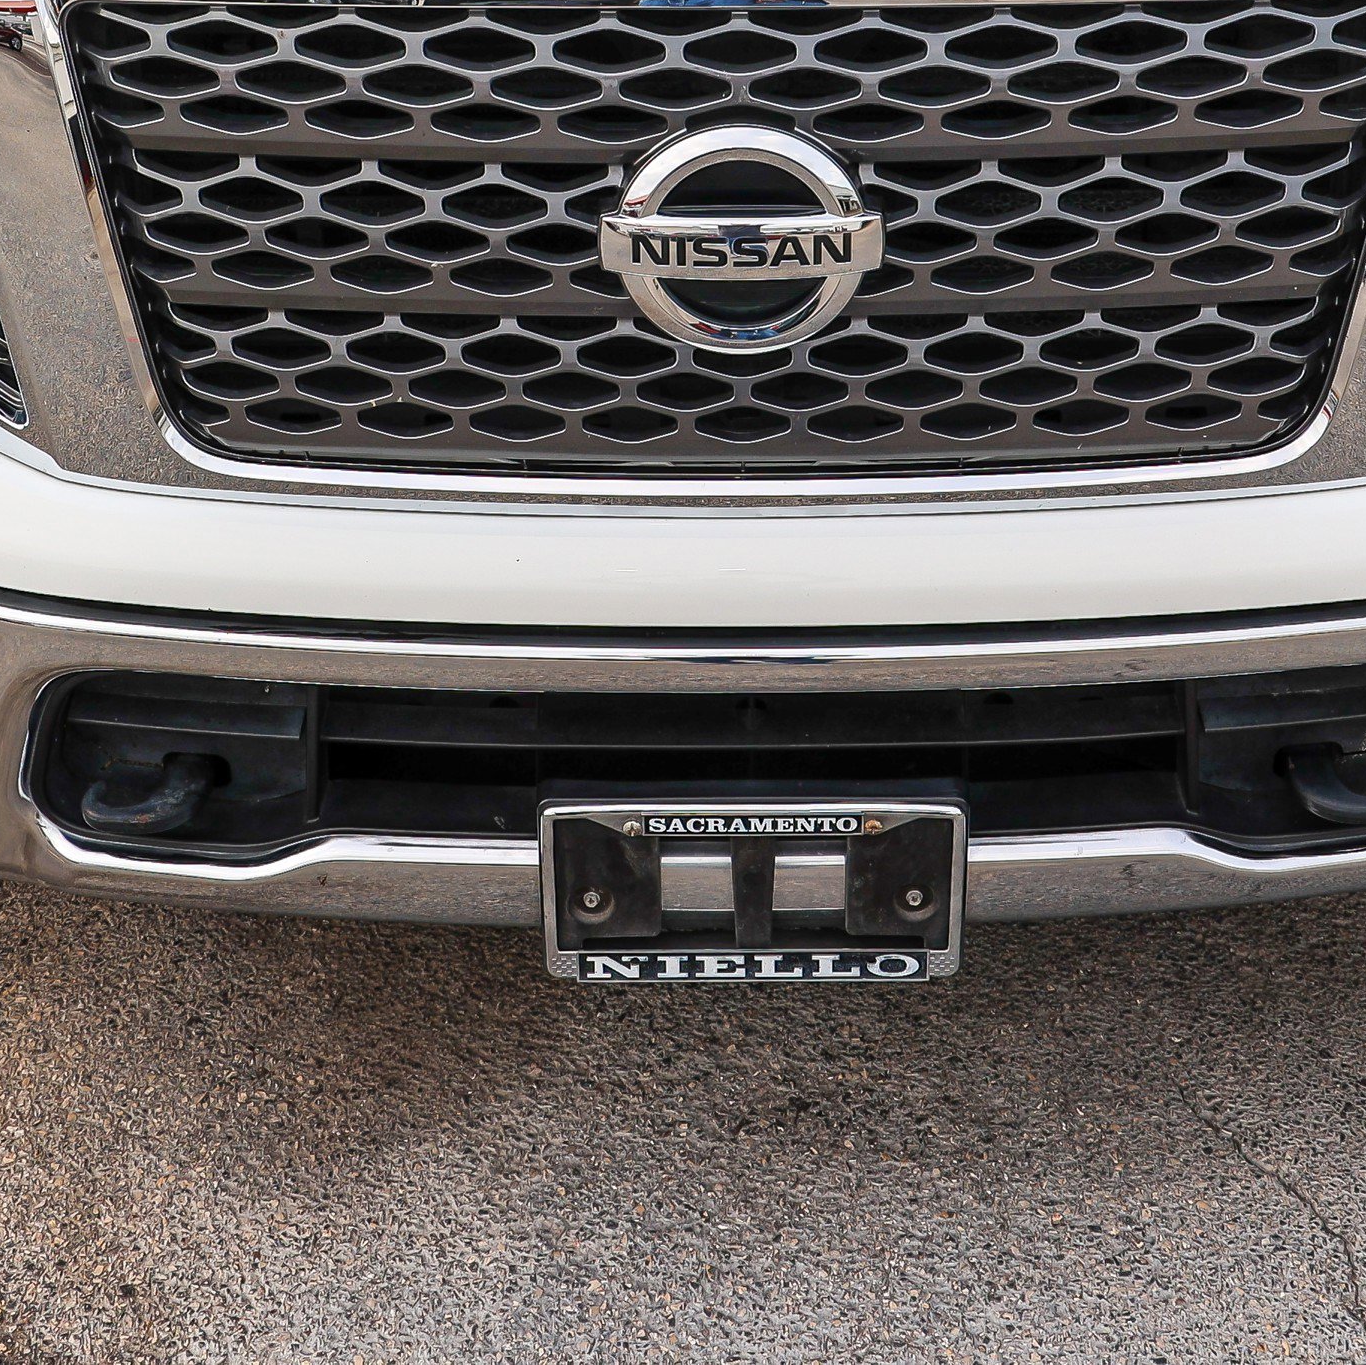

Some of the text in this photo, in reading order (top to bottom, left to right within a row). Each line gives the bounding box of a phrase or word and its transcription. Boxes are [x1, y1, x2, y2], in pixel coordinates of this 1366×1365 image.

[631, 233, 852, 268] NISSAN
[648, 816, 858, 834] SACRAMENTO
[585, 954, 920, 979] NIELLO
